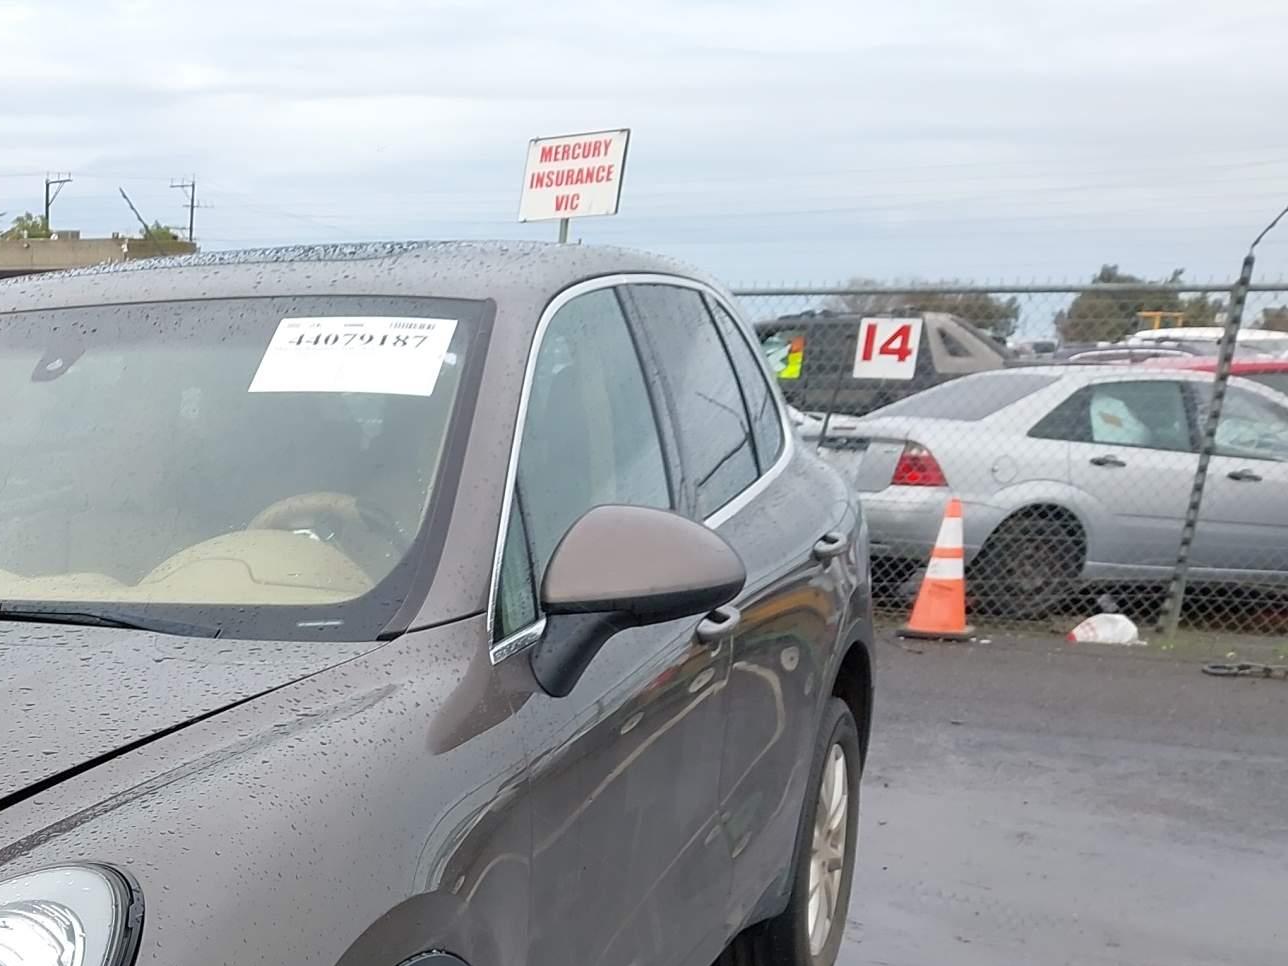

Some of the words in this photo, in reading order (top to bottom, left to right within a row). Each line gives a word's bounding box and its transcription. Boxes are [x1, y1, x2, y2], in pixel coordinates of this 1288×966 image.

[539, 138, 613, 163] MERCURY
[529, 164, 615, 189] INSURANCE
[555, 193, 580, 211] VIC
[288, 333, 429, 348] 44079187
[862, 323, 913, 363] 14
